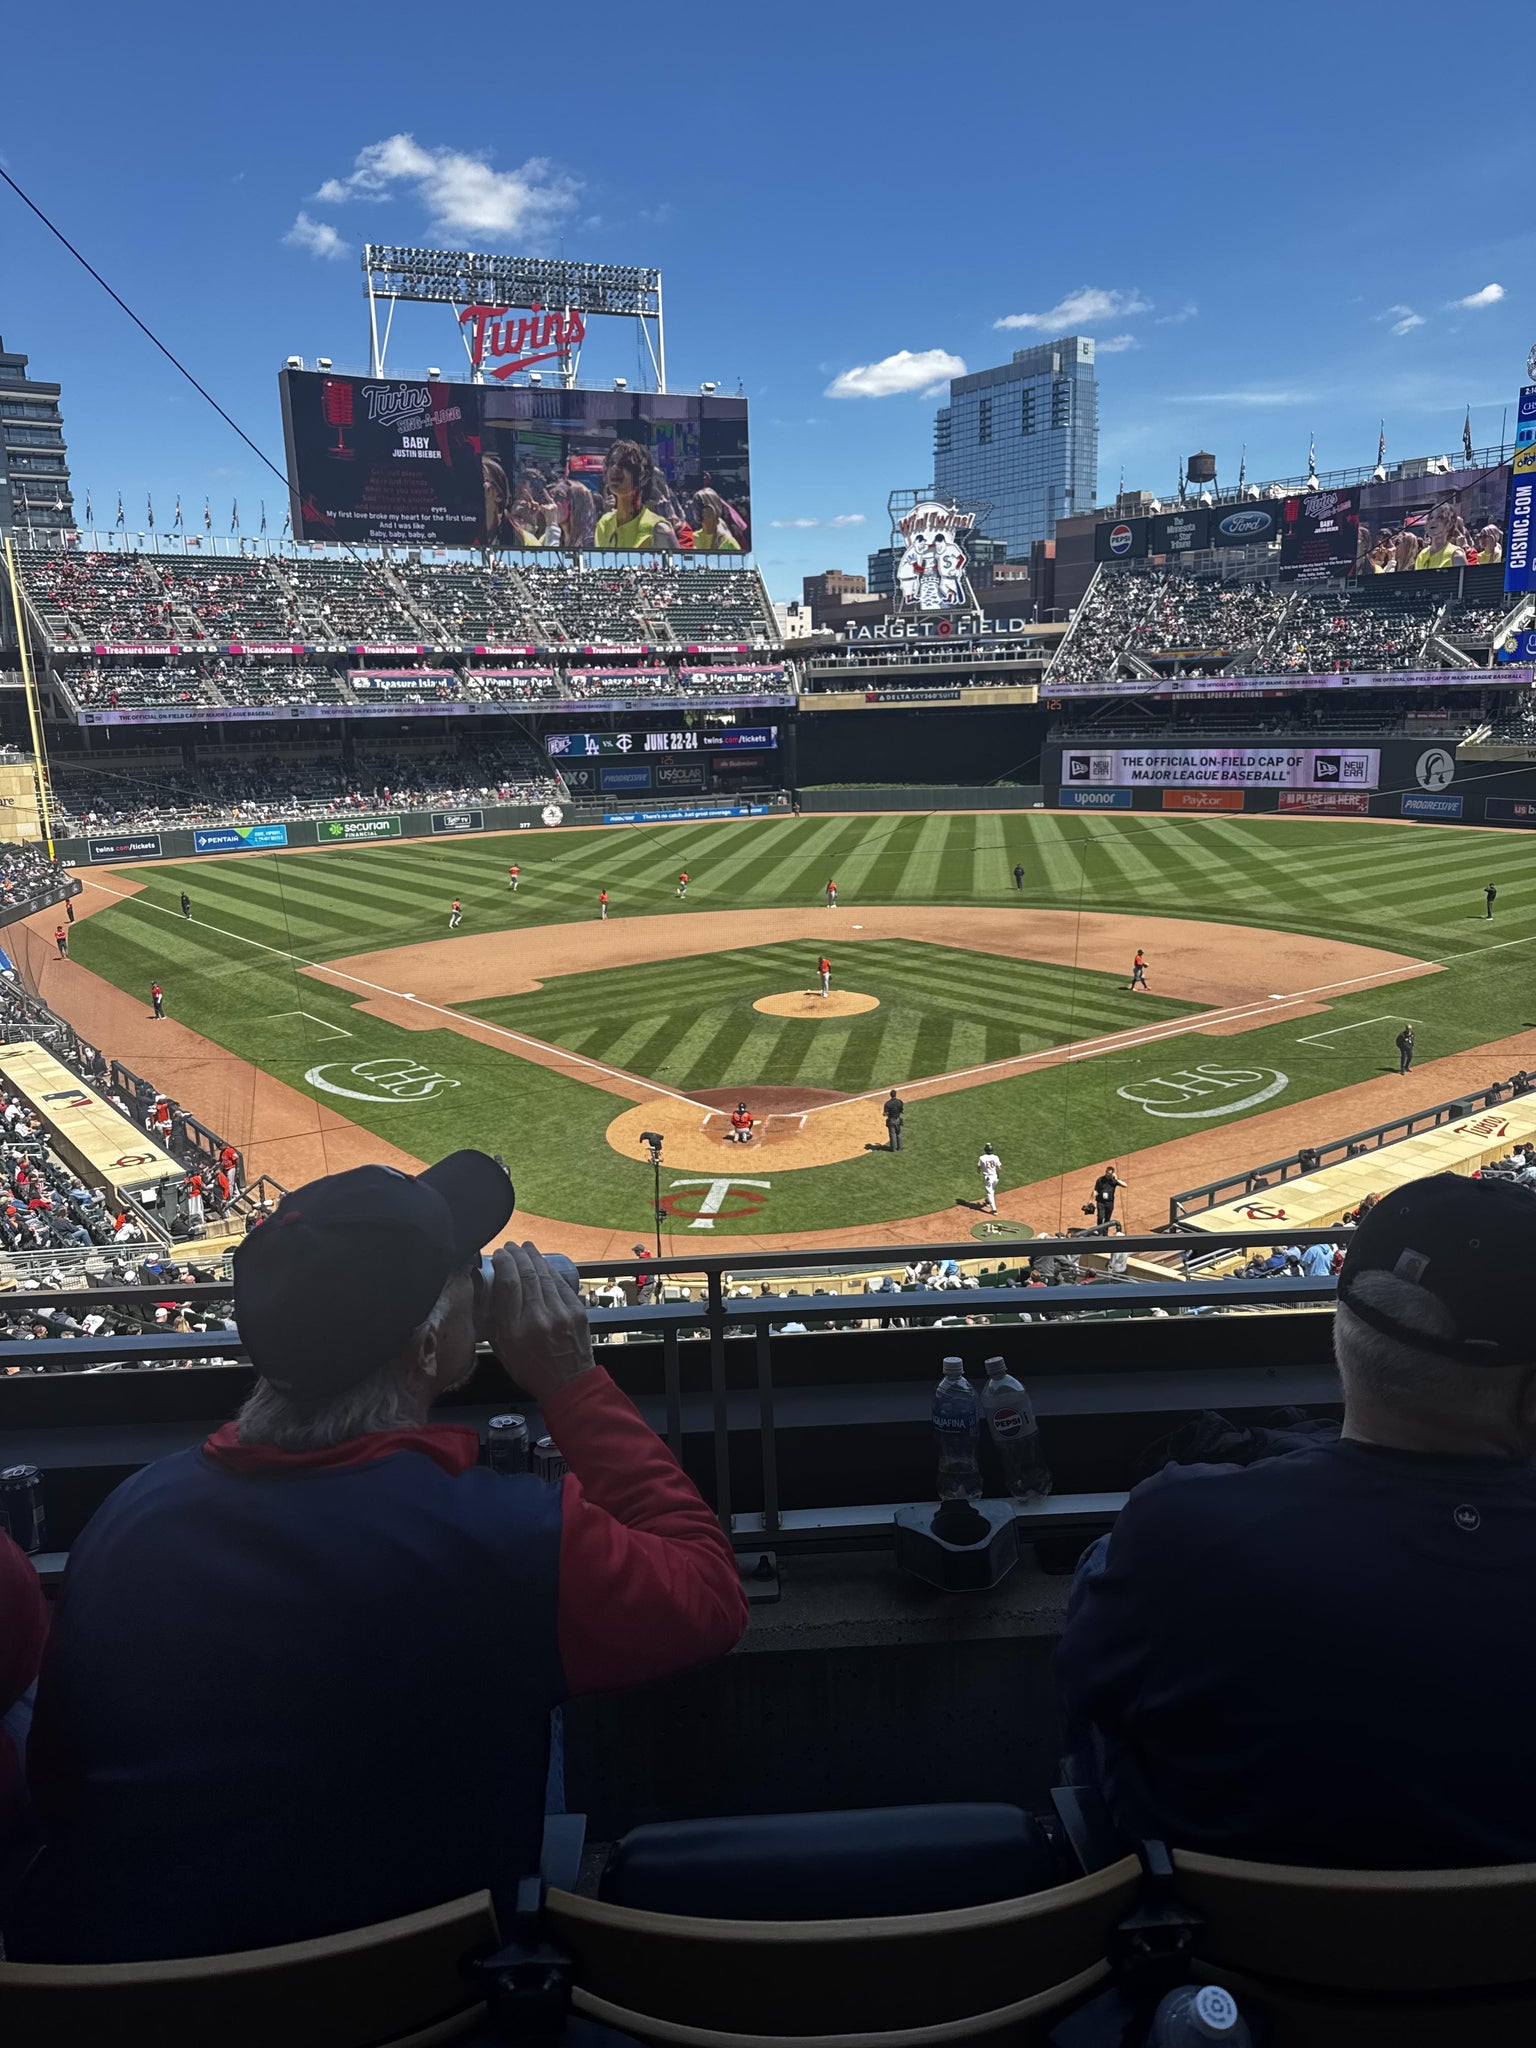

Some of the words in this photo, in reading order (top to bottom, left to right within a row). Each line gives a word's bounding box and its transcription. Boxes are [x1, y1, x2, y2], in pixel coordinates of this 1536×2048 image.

[460, 302, 585, 372] Twins
[362, 384, 432, 421] Twins
[396, 407, 462, 433] SING-A-LONG
[402, 436, 430, 449] BABY
[392, 450, 416, 458] JUSTIN
[418, 450, 442, 459] BIEBER
[1174, 517, 1184, 525] The
[1229, 516, 1260, 532] Ford
[1166, 524, 1196, 534] Minnesota
[1510, 485, 1533, 569] CHSINC.COM
[1111, 536, 1131, 544] PEPSI
[1179, 533, 1192, 541] Star
[1171, 540, 1191, 549] Tribune
[943, 555, 952, 568] S
[844, 623, 934, 639] TARGET
[958, 618, 1026, 634] FIELD
[584, 734, 600, 754] LA
[644, 734, 669, 751] JUNE
[1122, 757, 1144, 766] THE
[1146, 757, 1197, 767] OFFICIAL
[1200, 757, 1256, 767] ON-FIELD
[1258, 757, 1284, 767] CAP
[1287, 757, 1303, 767] OF
[1132, 771, 1171, 780] MAJOR
[1173, 771, 1219, 780] LEAGUE
[1344, 769, 1363, 777] ERA
[1075, 793, 1115, 805] uponor
[1182, 795, 1222, 806] Paycor
[1296, 793, 1323, 804] PLACE
[1338, 795, 1360, 805] HERE
[1405, 800, 1460, 811] PROGRESSIVE
[1514, 806, 1527, 814] us
[344, 821, 389, 832] securian
[208, 836, 238, 844] PENTAIR
[350, 1058, 461, 1096] CHS
[1116, 1064, 1263, 1104] CHS
[1454, 1116, 1508, 1138] Twins
[995, 1417, 1021, 1427] PEPSI
